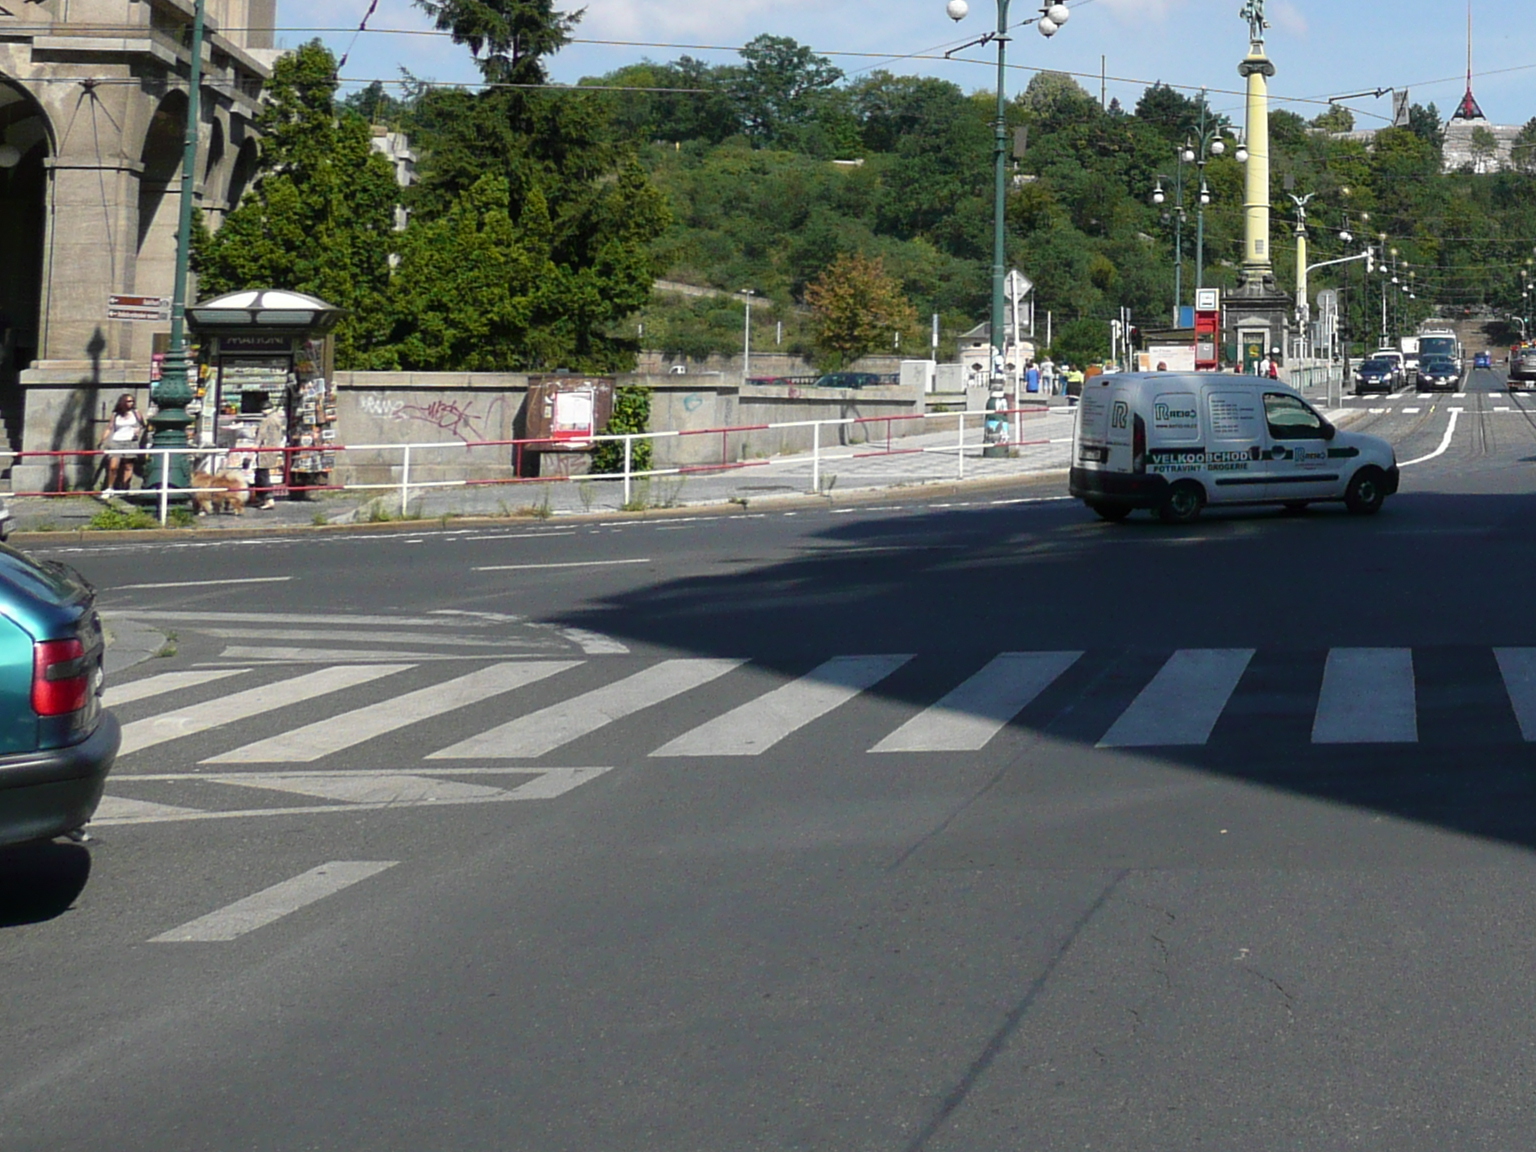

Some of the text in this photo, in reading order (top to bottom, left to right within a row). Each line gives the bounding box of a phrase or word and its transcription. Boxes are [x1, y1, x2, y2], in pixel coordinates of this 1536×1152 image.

[1152, 451, 1248, 464] VELKOOBCHOD
[1153, 462, 1248, 473] POTRAVINY DROGERIE
